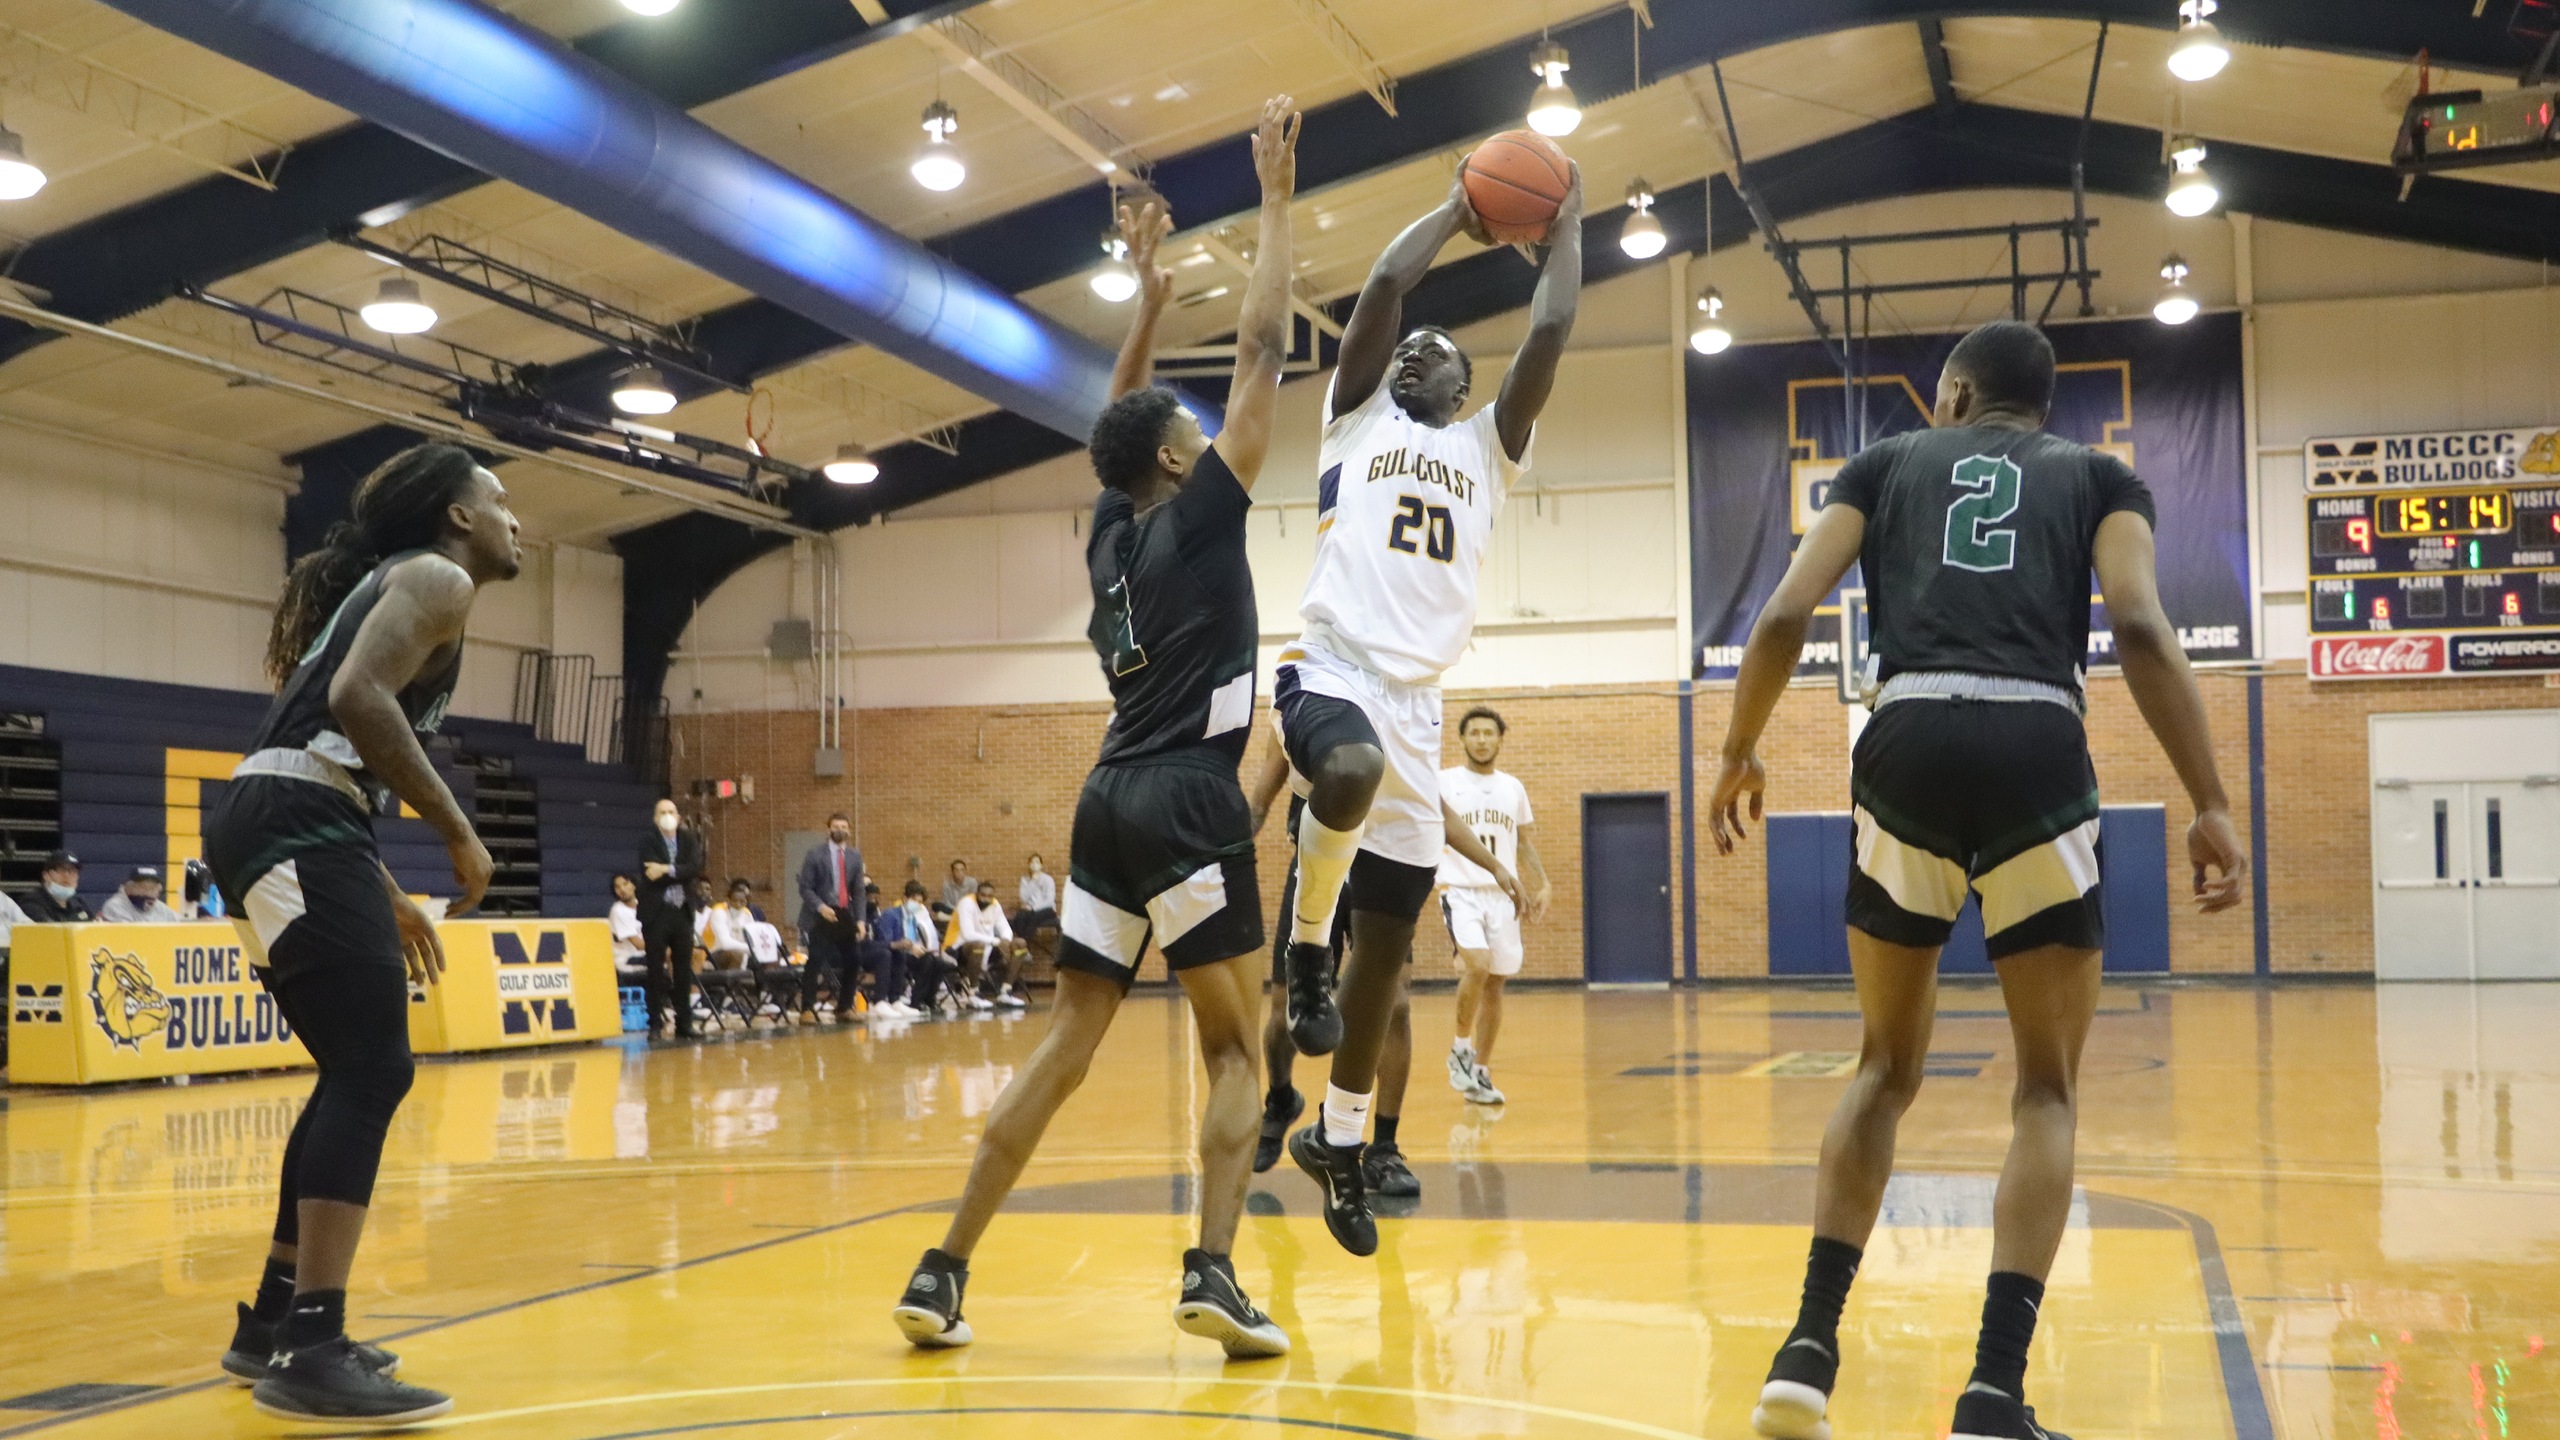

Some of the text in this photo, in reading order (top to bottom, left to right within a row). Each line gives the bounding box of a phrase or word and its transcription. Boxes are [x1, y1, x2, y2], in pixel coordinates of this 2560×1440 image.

[2384, 433, 2515, 459] MGCCC
[2385, 459, 2516, 484] BULLDOGS
[1942, 453, 2022, 573] 2
[2317, 498, 2365, 517] HOME
[2399, 494, 2501, 533] 15:14
[1387, 493, 1455, 565] 20
[2346, 517, 2371, 554] 9
[2336, 558, 2377, 572] BONUS
[2469, 541, 2481, 569] 1
[2512, 551, 2554, 565] BONUS
[2398, 576, 2444, 590] PLAYER
[2463, 573, 2502, 587] FOULS
[2344, 592, 2354, 619] 1
[2373, 597, 2389, 619] 6
[2503, 593, 2520, 614] 6
[175, 947, 240, 984] HOME
[500, 973, 569, 991] GULF COAST
